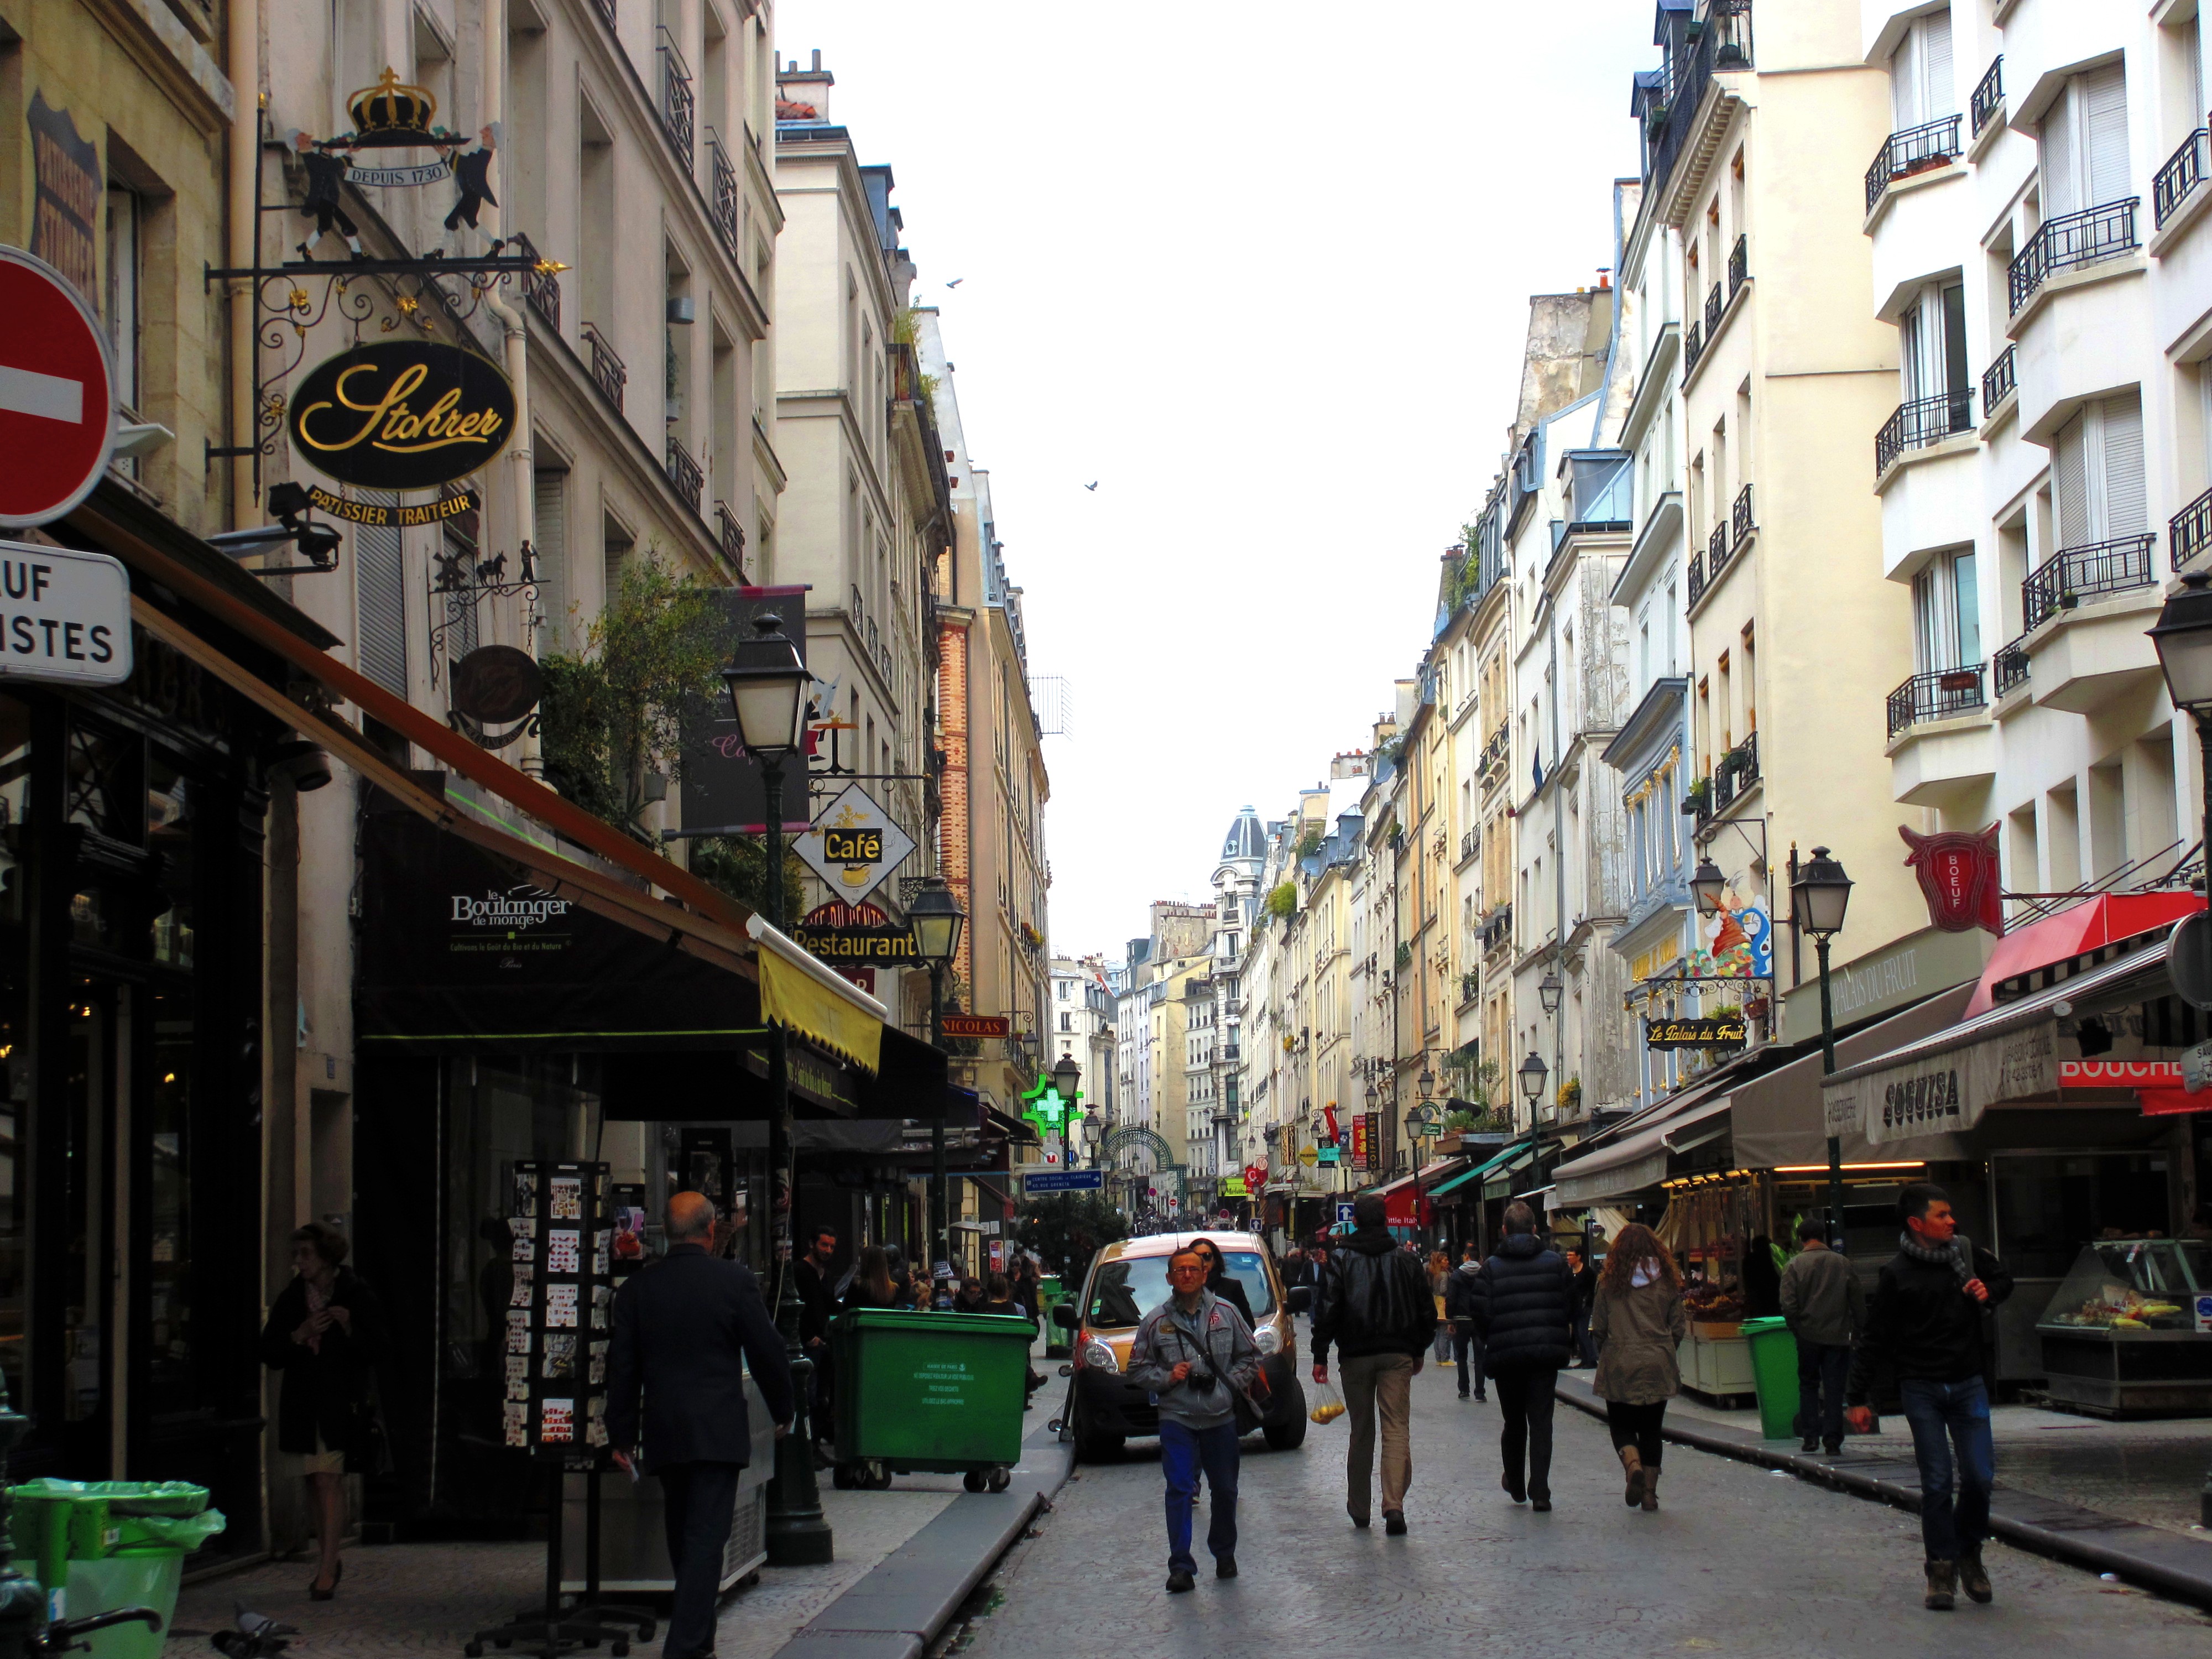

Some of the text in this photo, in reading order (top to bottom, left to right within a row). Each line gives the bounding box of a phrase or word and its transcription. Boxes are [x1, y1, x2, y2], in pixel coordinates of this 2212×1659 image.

[352, 167, 442, 185] DEPUIS 1730
[299, 363, 503, 452] Stohrer
[310, 489, 471, 525] PATISSIER TRAITEUR
[0, 560, 51, 602] UF
[826, 833, 881, 859] Café
[487, 889, 498, 900] le
[1949, 855, 1961, 908] BOEUF
[451, 895, 573, 924] Boulanger
[473, 915, 535, 930] de monge
[450, 943, 478, 951] Cultivons
[793, 930, 917, 956] Restaurant
[1884, 949, 1917, 995] FRUIT
[942, 1020, 1000, 1033] NICOLAS
[1648, 1024, 1744, 1041] Le Palais du Fruit
[1883, 1068, 1960, 1128] SOGUISA
[1369, 1114, 1377, 1169] COIFFIRST
